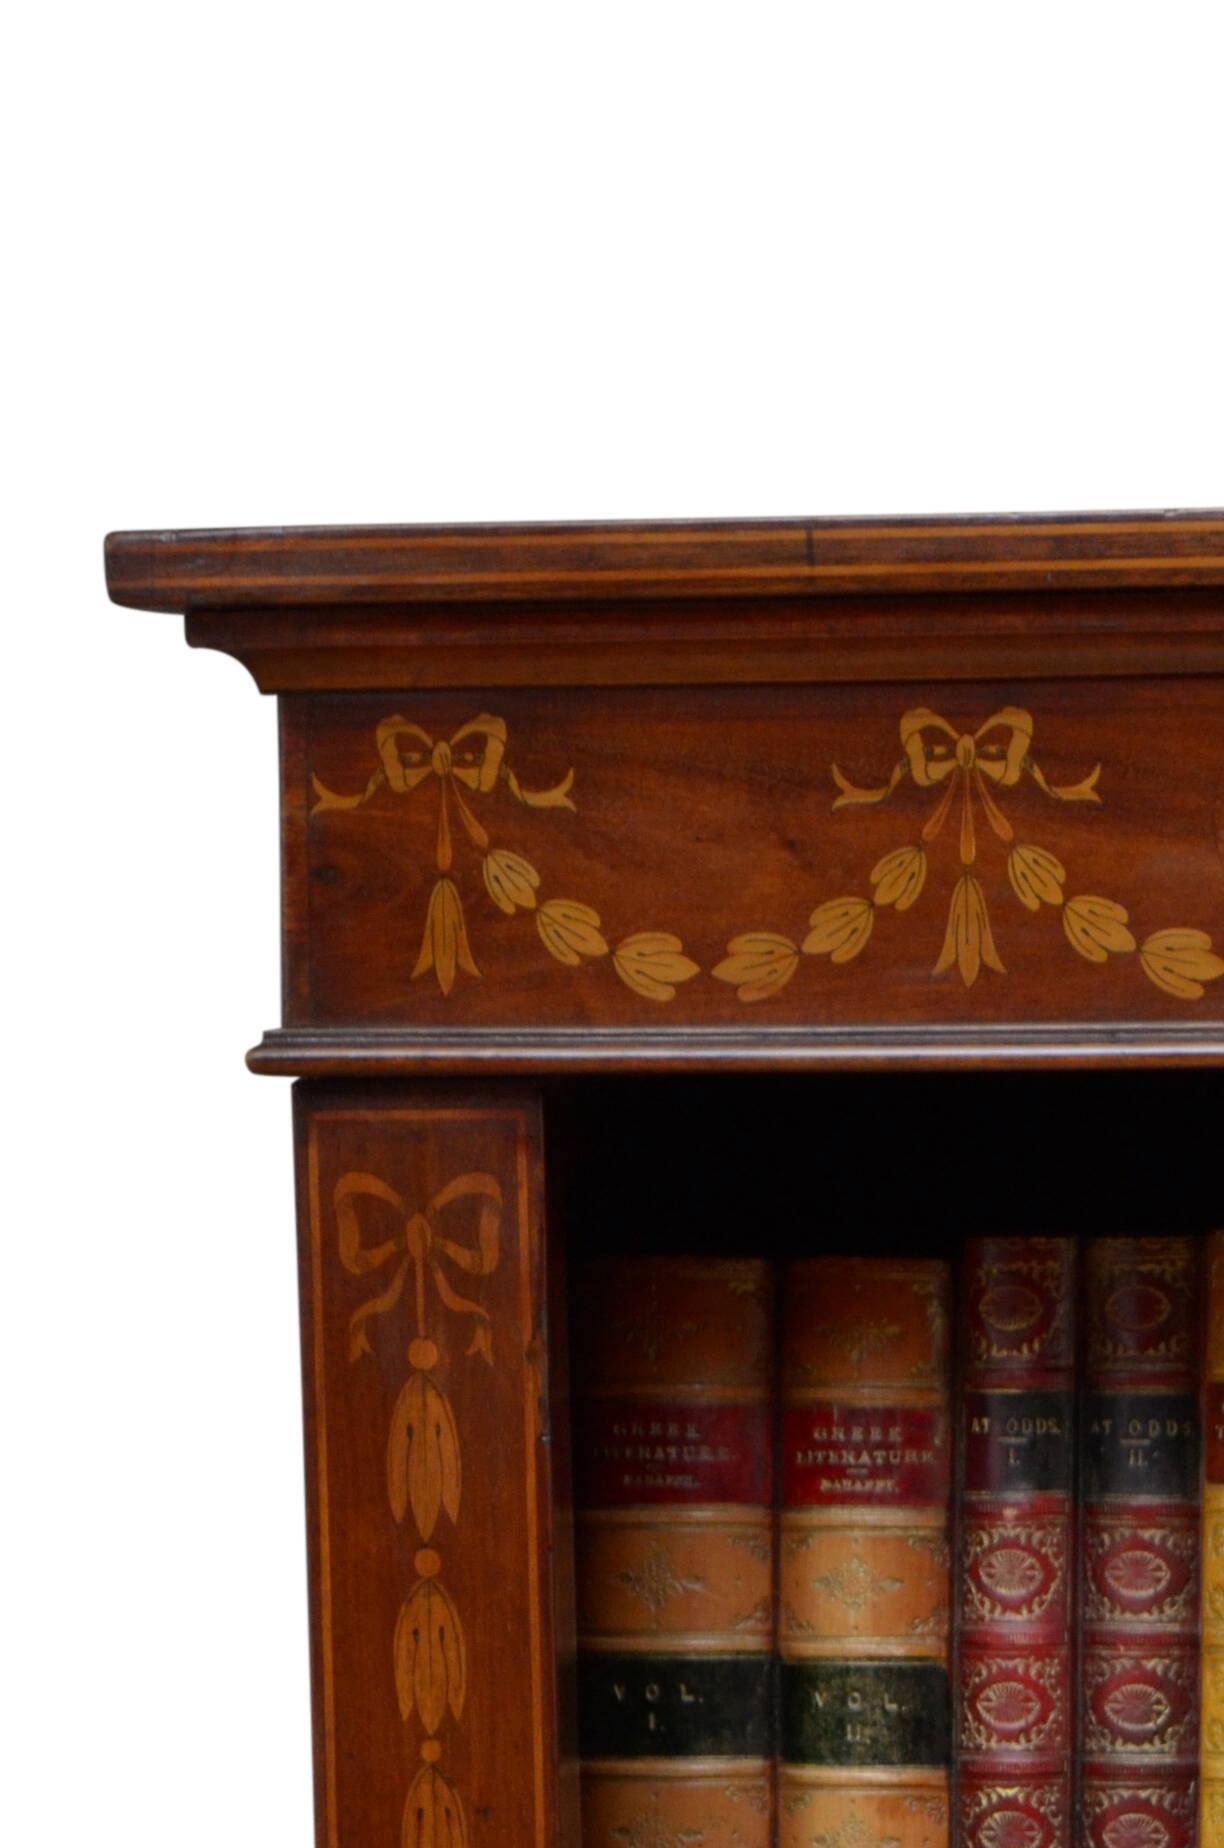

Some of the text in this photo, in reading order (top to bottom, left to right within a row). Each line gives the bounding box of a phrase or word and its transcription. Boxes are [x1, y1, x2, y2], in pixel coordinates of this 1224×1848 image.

[813, 1425, 902, 1442] GREEK
[971, 1416, 992, 1434] AT
[1090, 1418, 1113, 1436] AT
